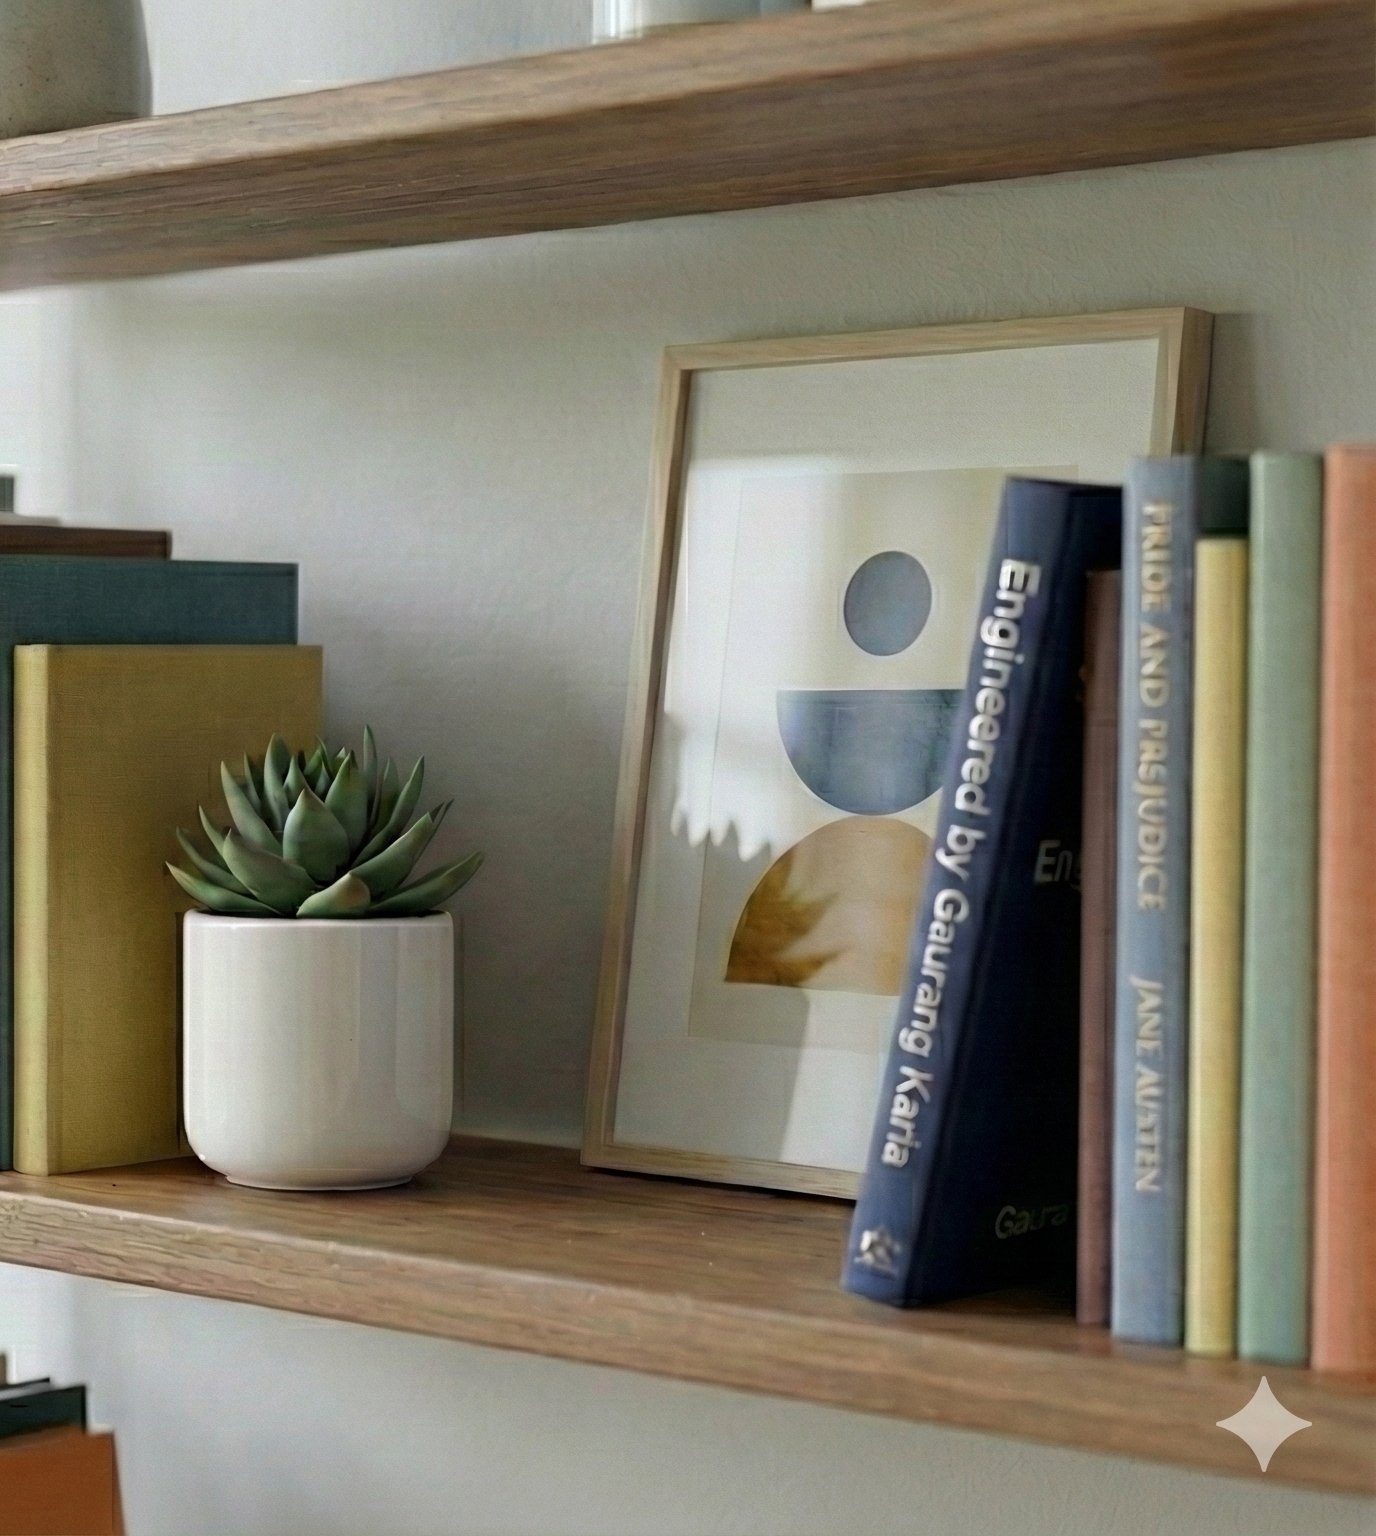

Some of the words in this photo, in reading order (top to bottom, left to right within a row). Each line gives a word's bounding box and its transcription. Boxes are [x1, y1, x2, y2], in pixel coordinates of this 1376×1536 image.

[1140, 500, 1173, 613] PRIDE
[955, 558, 1042, 815] Engineered
[1138, 621, 1171, 708] AND
[935, 824, 987, 884] by
[897, 889, 970, 1058] Gaurang
[1128, 973, 1164, 1058] JANE
[880, 1065, 935, 1169] Karia
